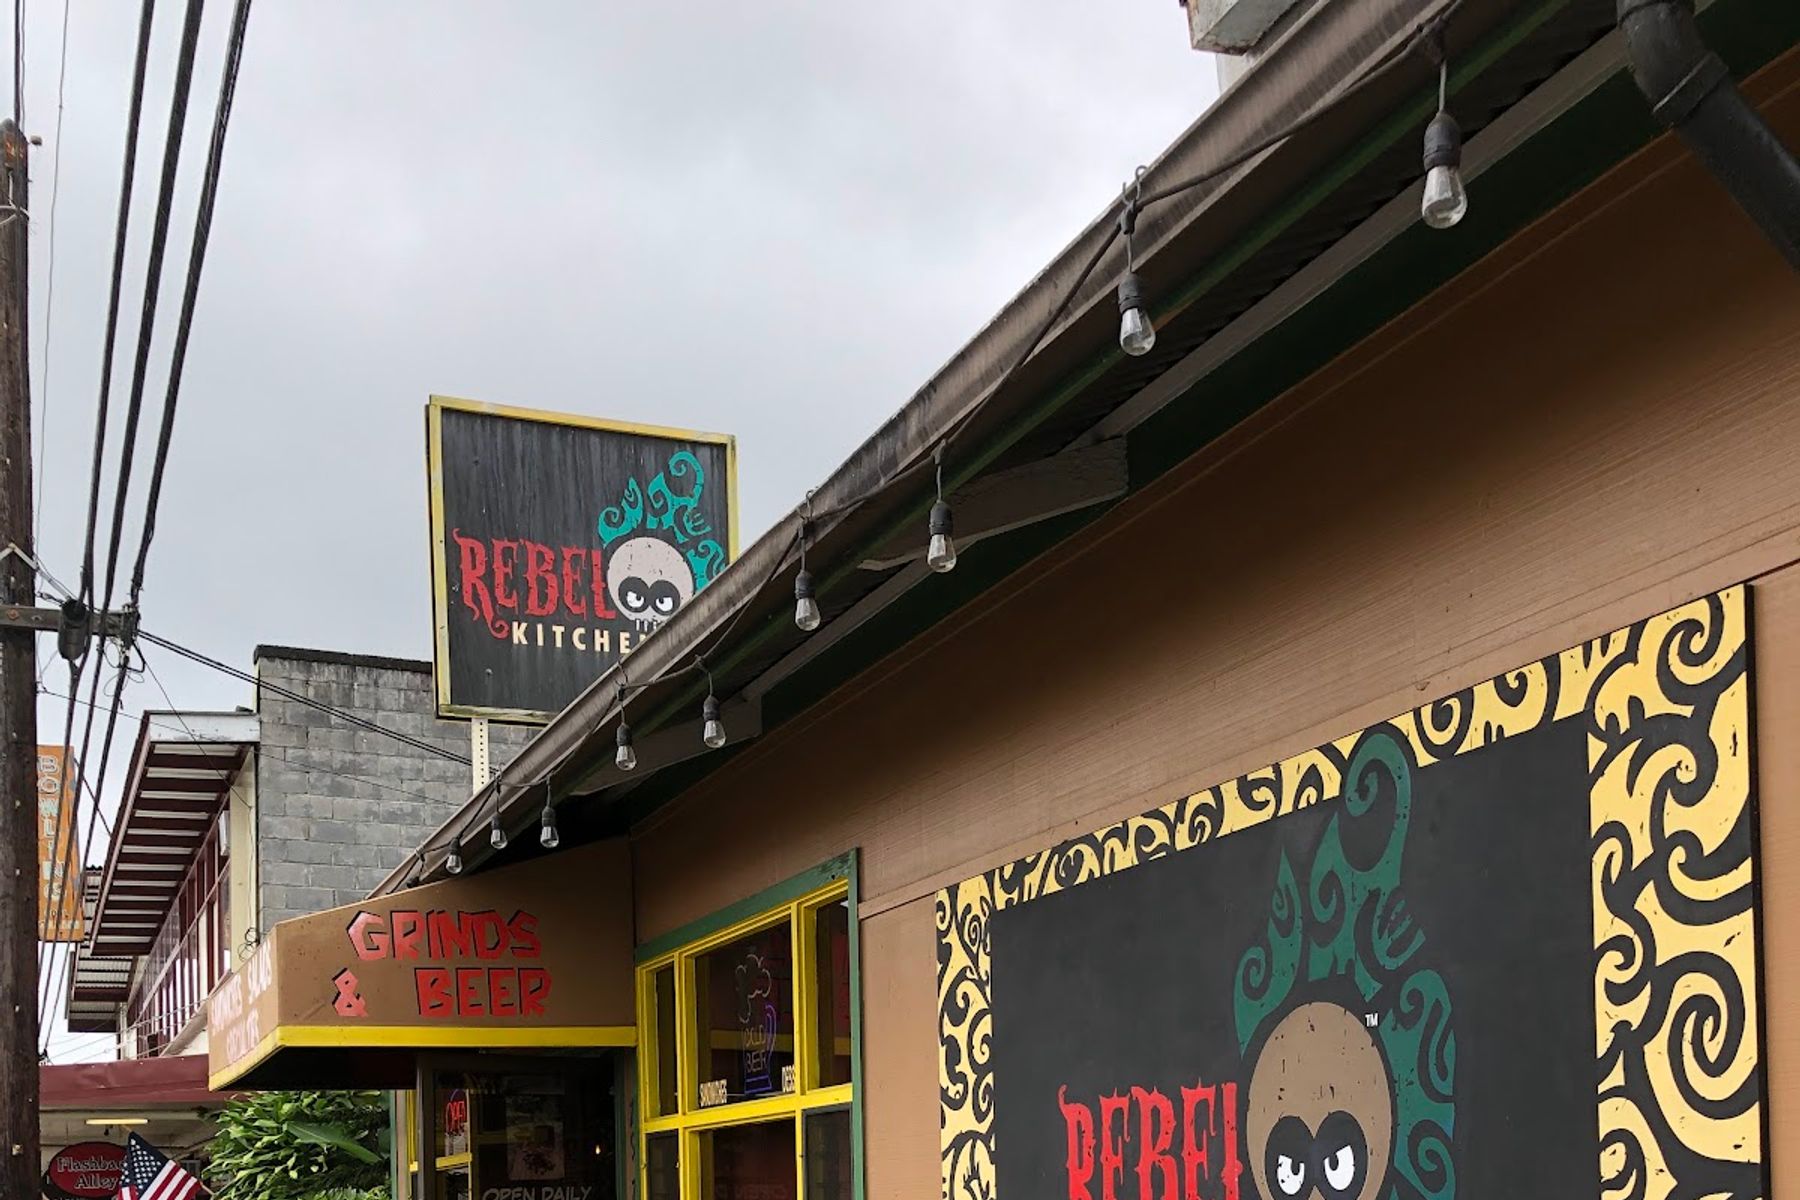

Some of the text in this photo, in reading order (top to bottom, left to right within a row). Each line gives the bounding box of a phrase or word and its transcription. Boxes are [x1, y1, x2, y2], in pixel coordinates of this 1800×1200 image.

[452, 528, 616, 638] REBEL
[512, 621, 650, 655] KITCHE
[346, 909, 543, 962] GRINDS
[331, 967, 370, 1019] &
[414, 967, 552, 1019] BEER
[74, 1173, 119, 1191] Alley
